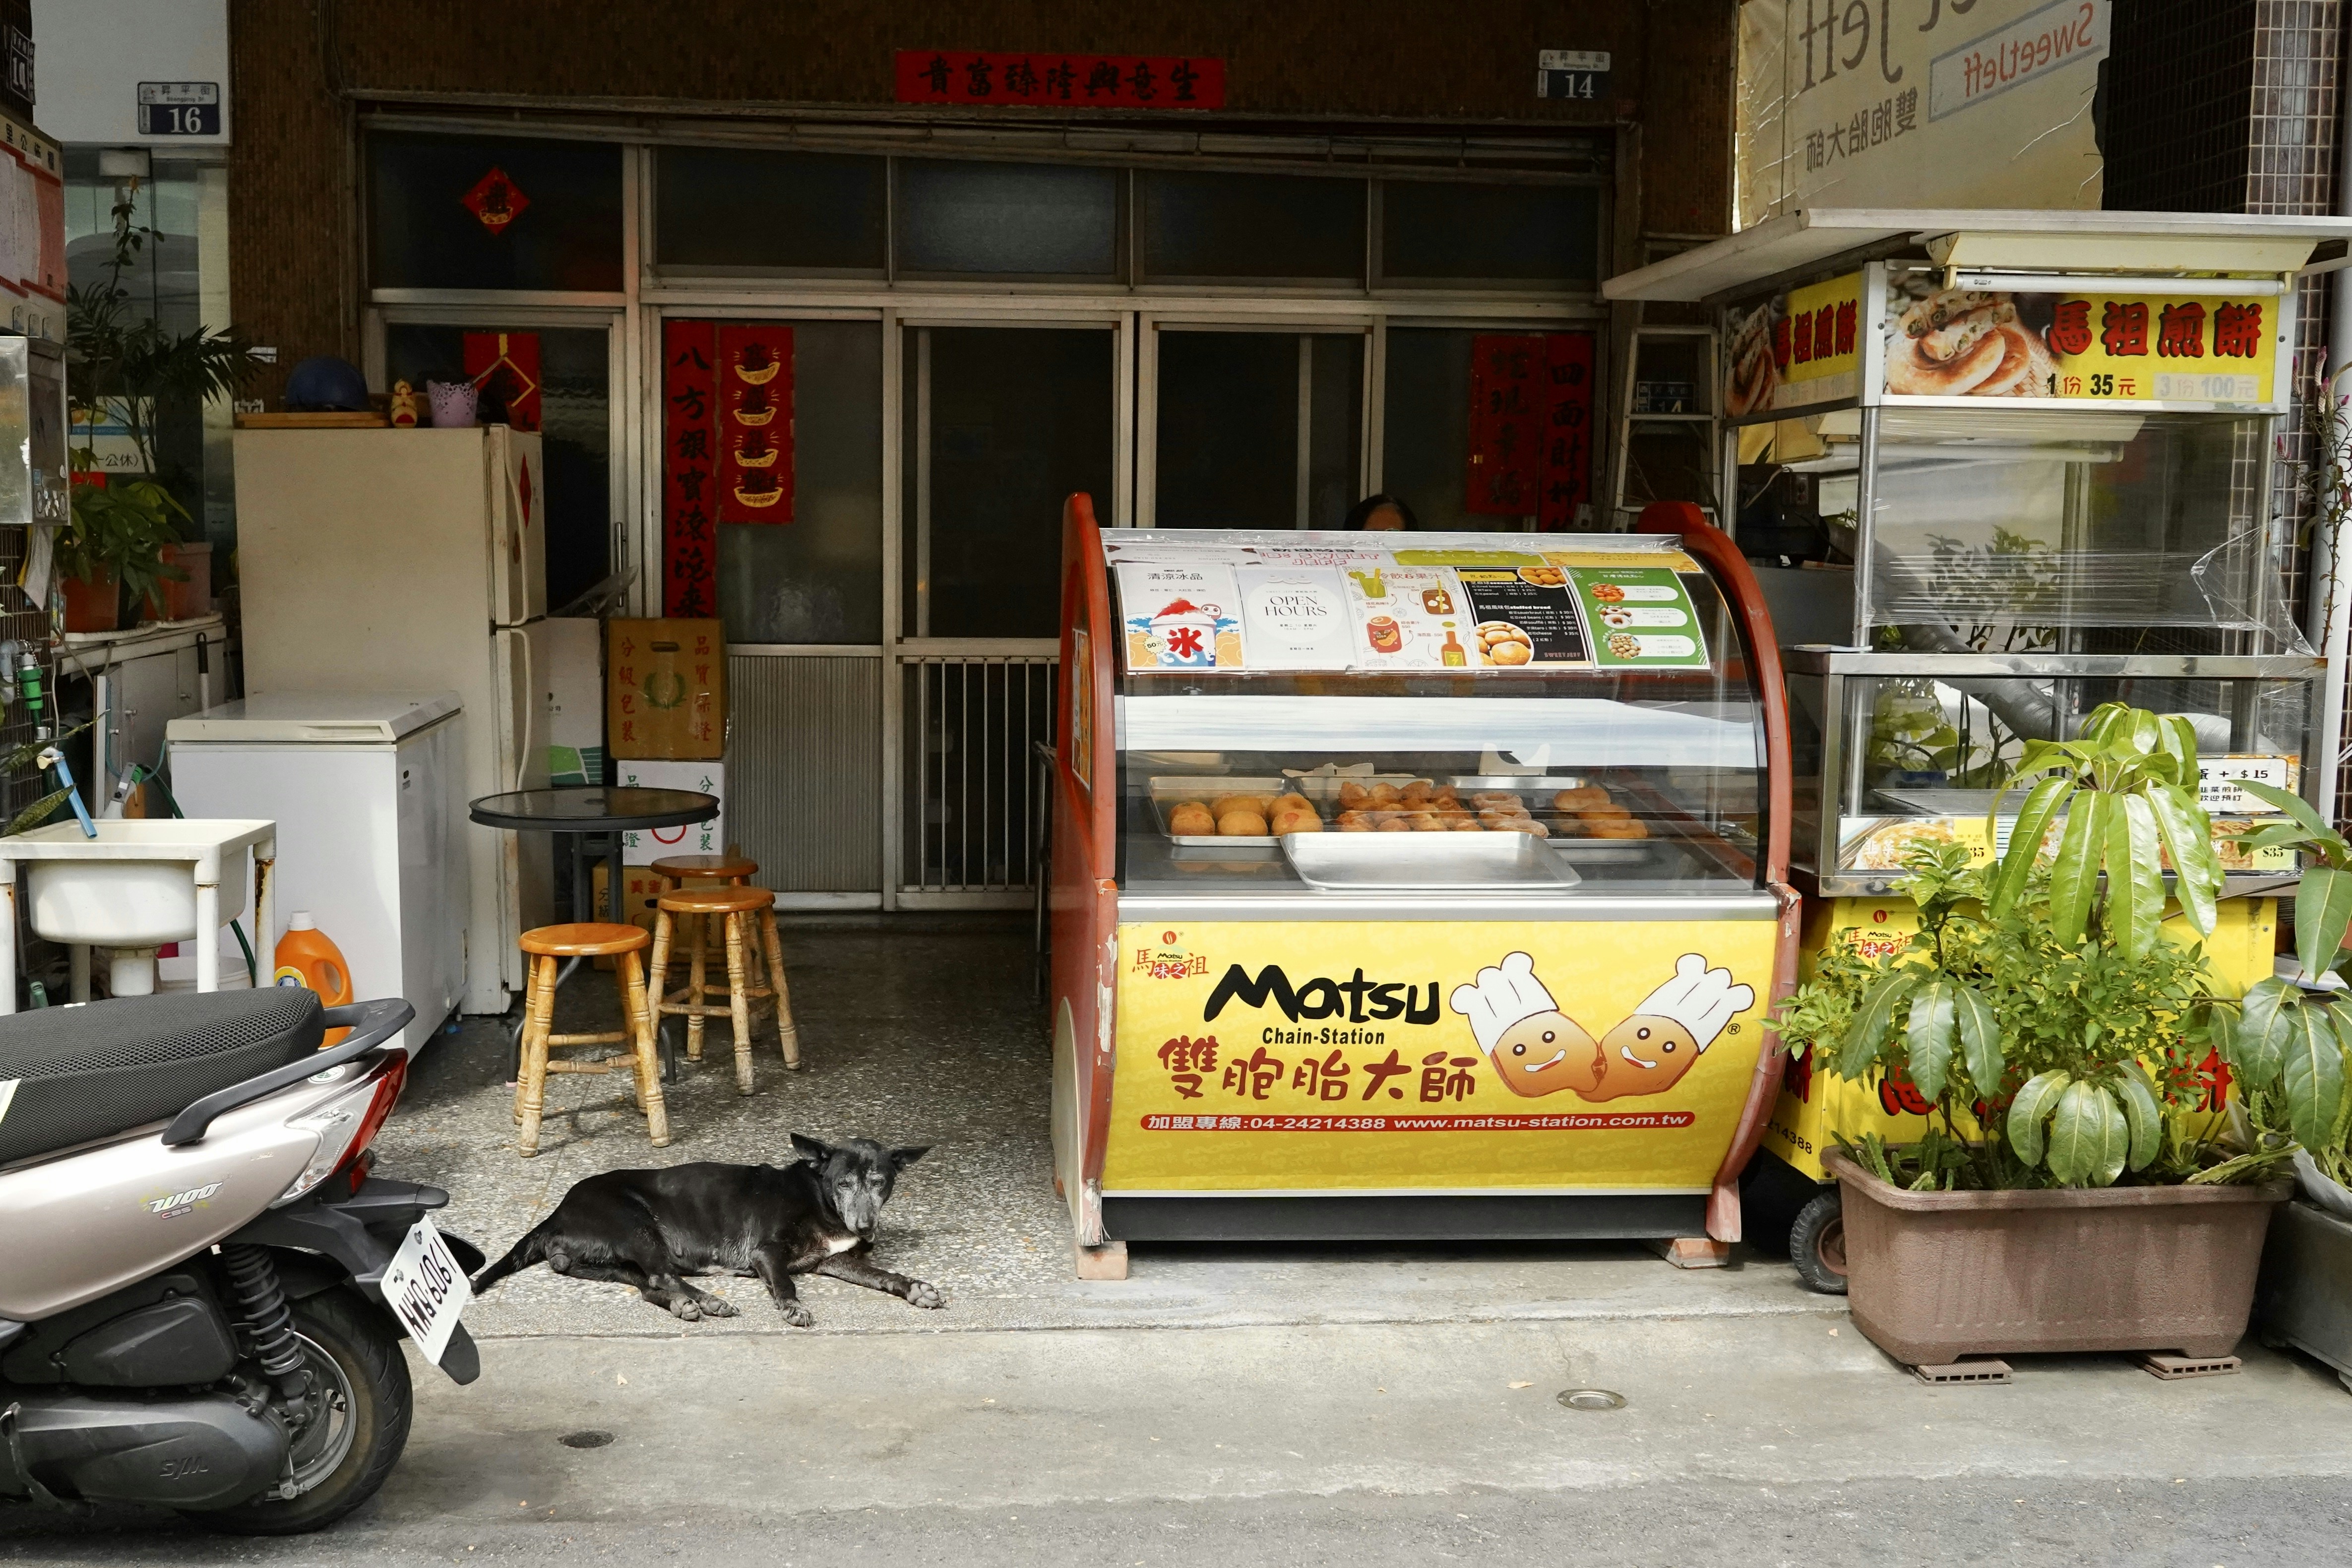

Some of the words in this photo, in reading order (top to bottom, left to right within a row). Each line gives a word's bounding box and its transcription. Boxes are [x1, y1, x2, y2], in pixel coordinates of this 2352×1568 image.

[1565, 74, 1594, 98] 14
[169, 107, 202, 133] 16
[2045, 300, 2263, 359] 馬祖煎餅
[1265, 606, 1327, 616] HOURS
[1270, 596, 1317, 605] OPEN
[2262, 847, 2284, 858] $35
[1204, 964, 1440, 1024] Matsu
[1262, 1027, 1385, 1045] Chain-Station
[1157, 1035, 1478, 1102] 雙胞胎大師
[1394, 1114, 1688, 1129] www.matsu-station.com.tw
[161, 1206, 192, 1219] CBS
[159, 1456, 209, 1480] SYM
